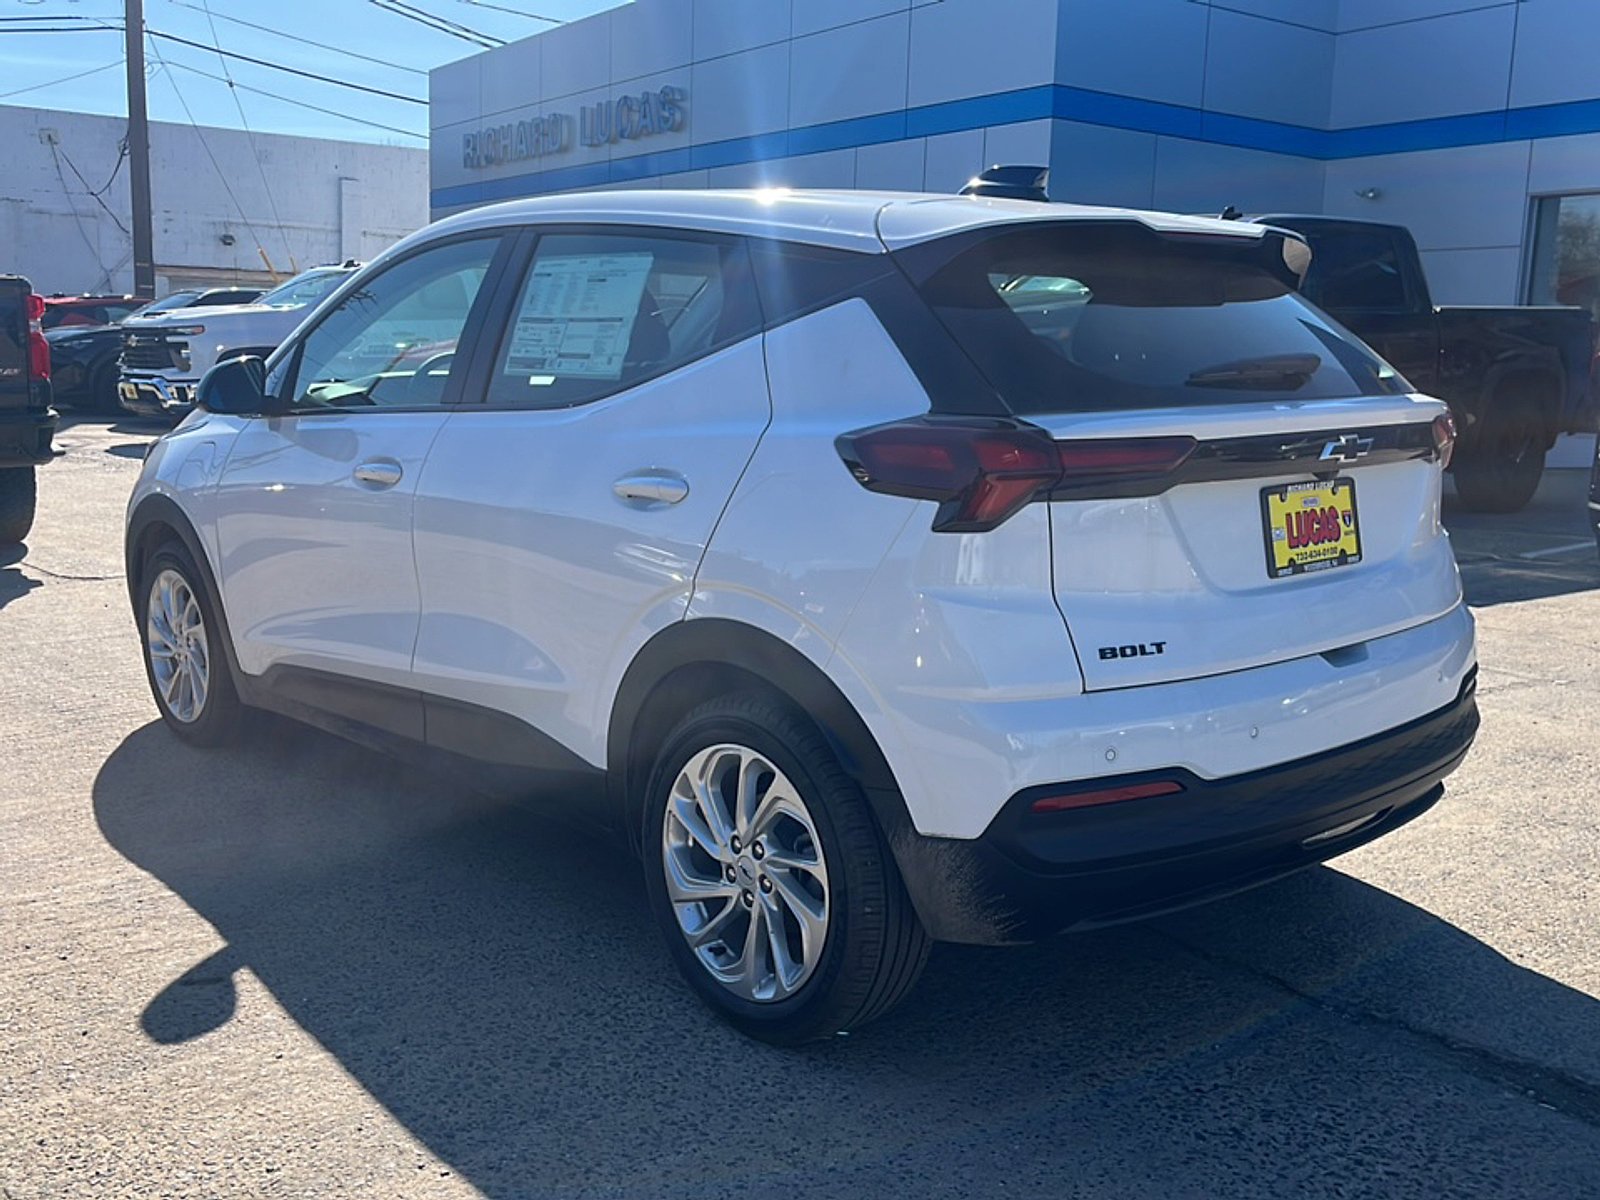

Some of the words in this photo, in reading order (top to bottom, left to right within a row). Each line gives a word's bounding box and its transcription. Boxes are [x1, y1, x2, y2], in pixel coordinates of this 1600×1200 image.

[463, 113, 572, 169] RICHARD
[580, 85, 685, 148] LUCAS
[1285, 505, 1341, 549] LUCAS
[1098, 641, 1167, 660] BOLT
